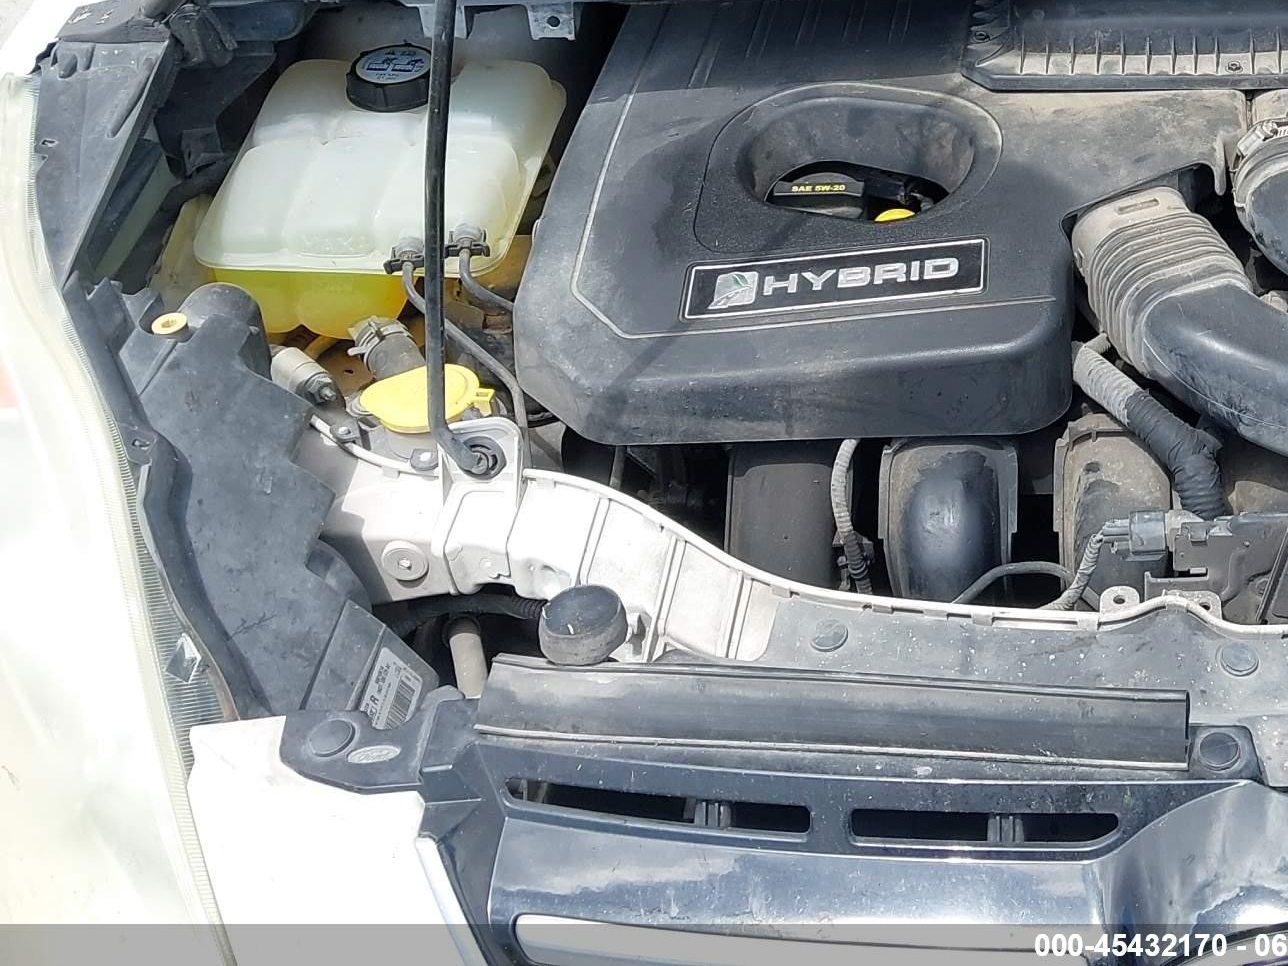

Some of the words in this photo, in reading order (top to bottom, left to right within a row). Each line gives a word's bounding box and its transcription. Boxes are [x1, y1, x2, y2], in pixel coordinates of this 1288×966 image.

[791, 185, 813, 193] SAE
[814, 183, 846, 193] 5W-20
[762, 257, 960, 296] HYBRID
